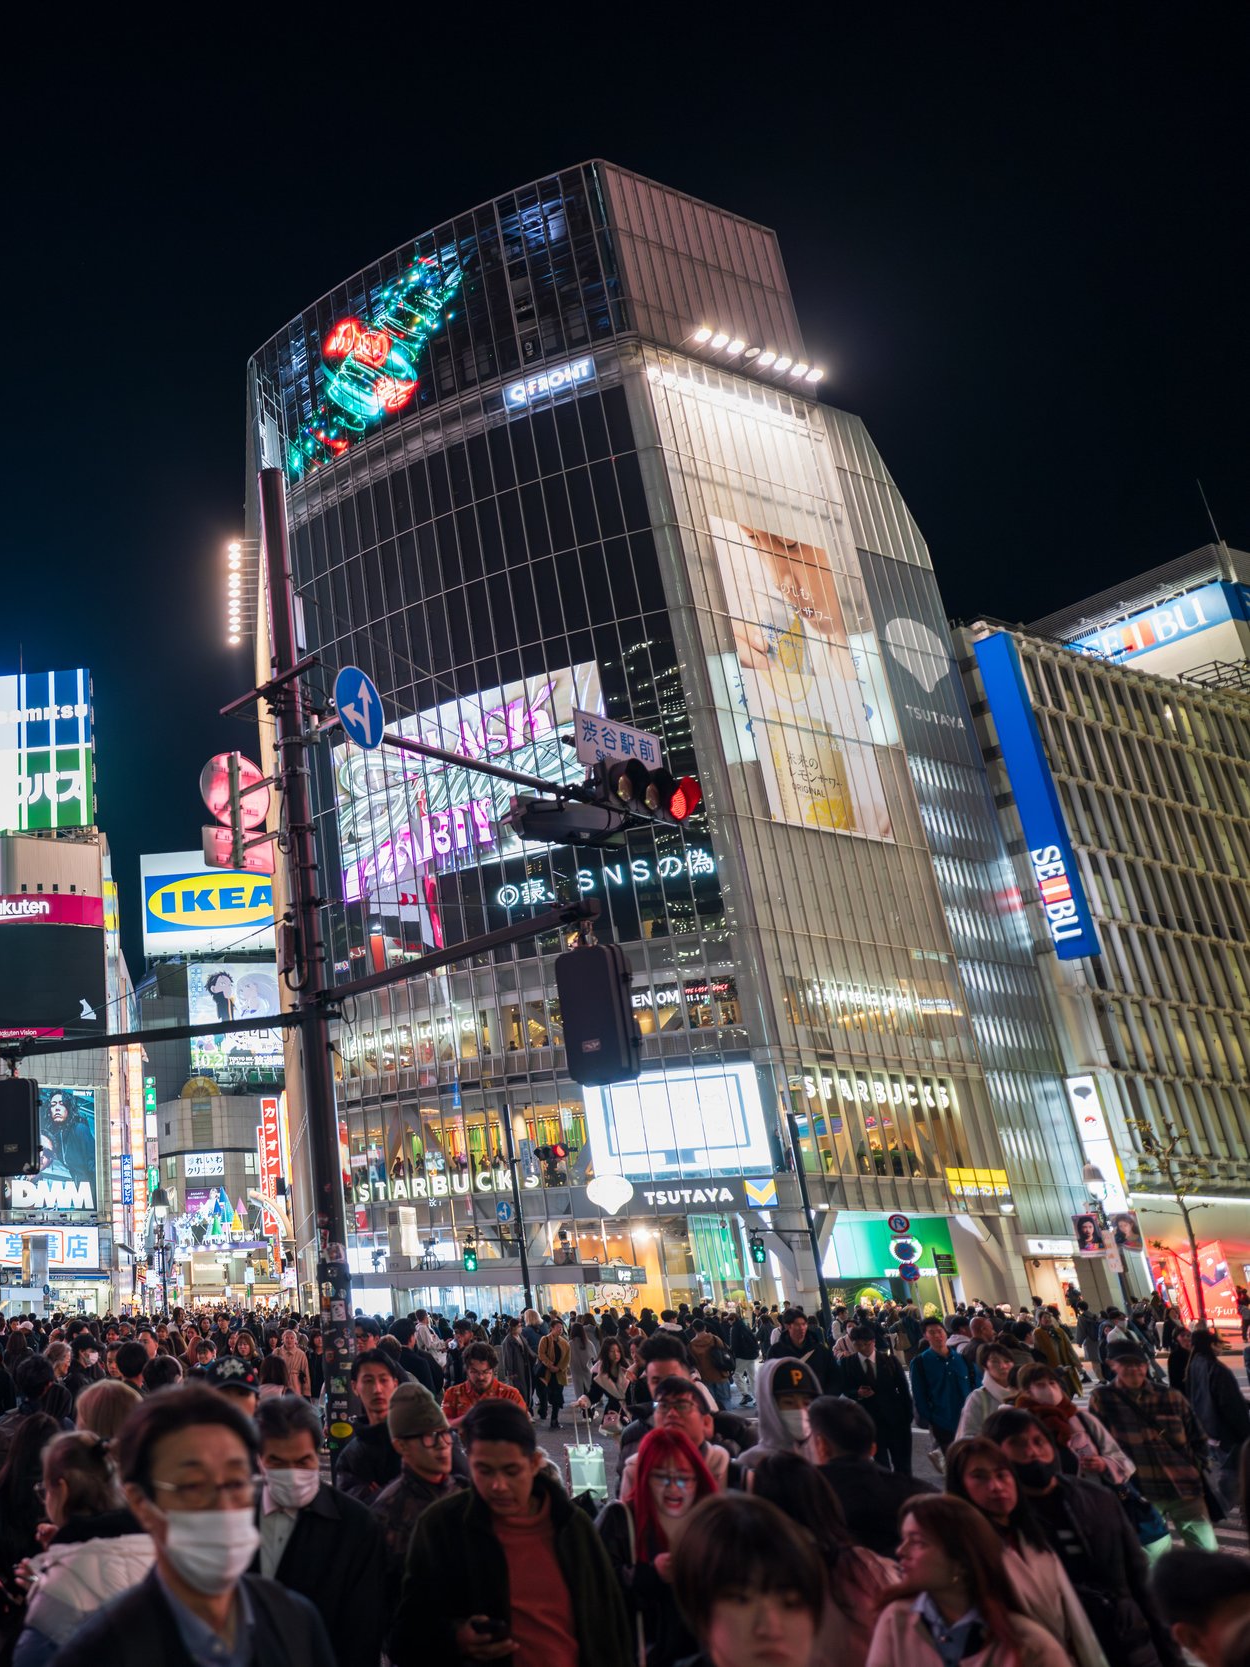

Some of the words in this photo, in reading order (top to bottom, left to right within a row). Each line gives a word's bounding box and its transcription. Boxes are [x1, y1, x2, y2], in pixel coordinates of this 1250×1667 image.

[906, 703, 968, 730] TSUTAYA
[582, 718, 656, 763] 渋谷駅前
[161, 885, 273, 914] IKEA
[1031, 844, 1083, 944] SEIBU
[631, 990, 679, 1008] ENOM
[19, 1028, 38, 1036] Vision
[803, 1076, 951, 1109] STARBUCKS
[263, 1106, 280, 1168] カラオケ
[11, 1179, 94, 1210] DMM
[643, 1187, 735, 1206] TSUTAYA
[790, 1369, 803, 1386] P
